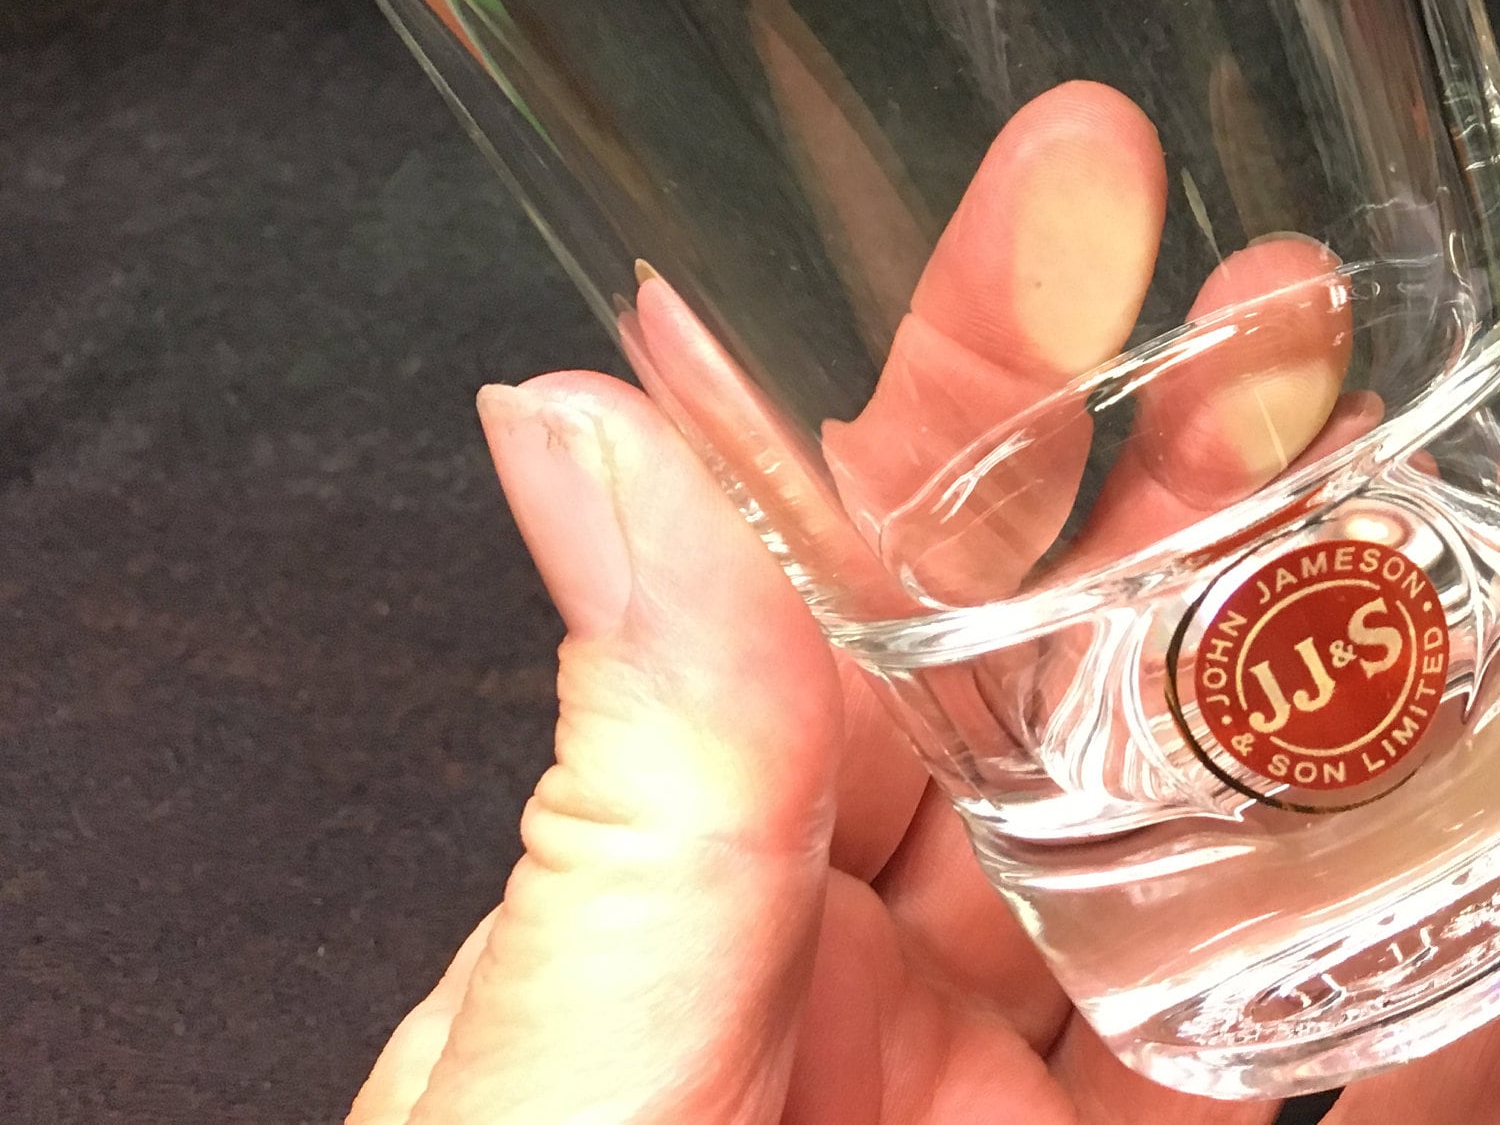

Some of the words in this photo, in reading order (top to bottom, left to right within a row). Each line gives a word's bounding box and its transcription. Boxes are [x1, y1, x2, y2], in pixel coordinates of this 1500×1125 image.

[1202, 610, 1248, 707] JOHN
[1256, 546, 1426, 605] JAMESON
[1230, 732, 1255, 757] &
[1267, 754, 1347, 783] SON
[1361, 625, 1444, 773] LIMITED
[1248, 597, 1403, 734] JJ&S
